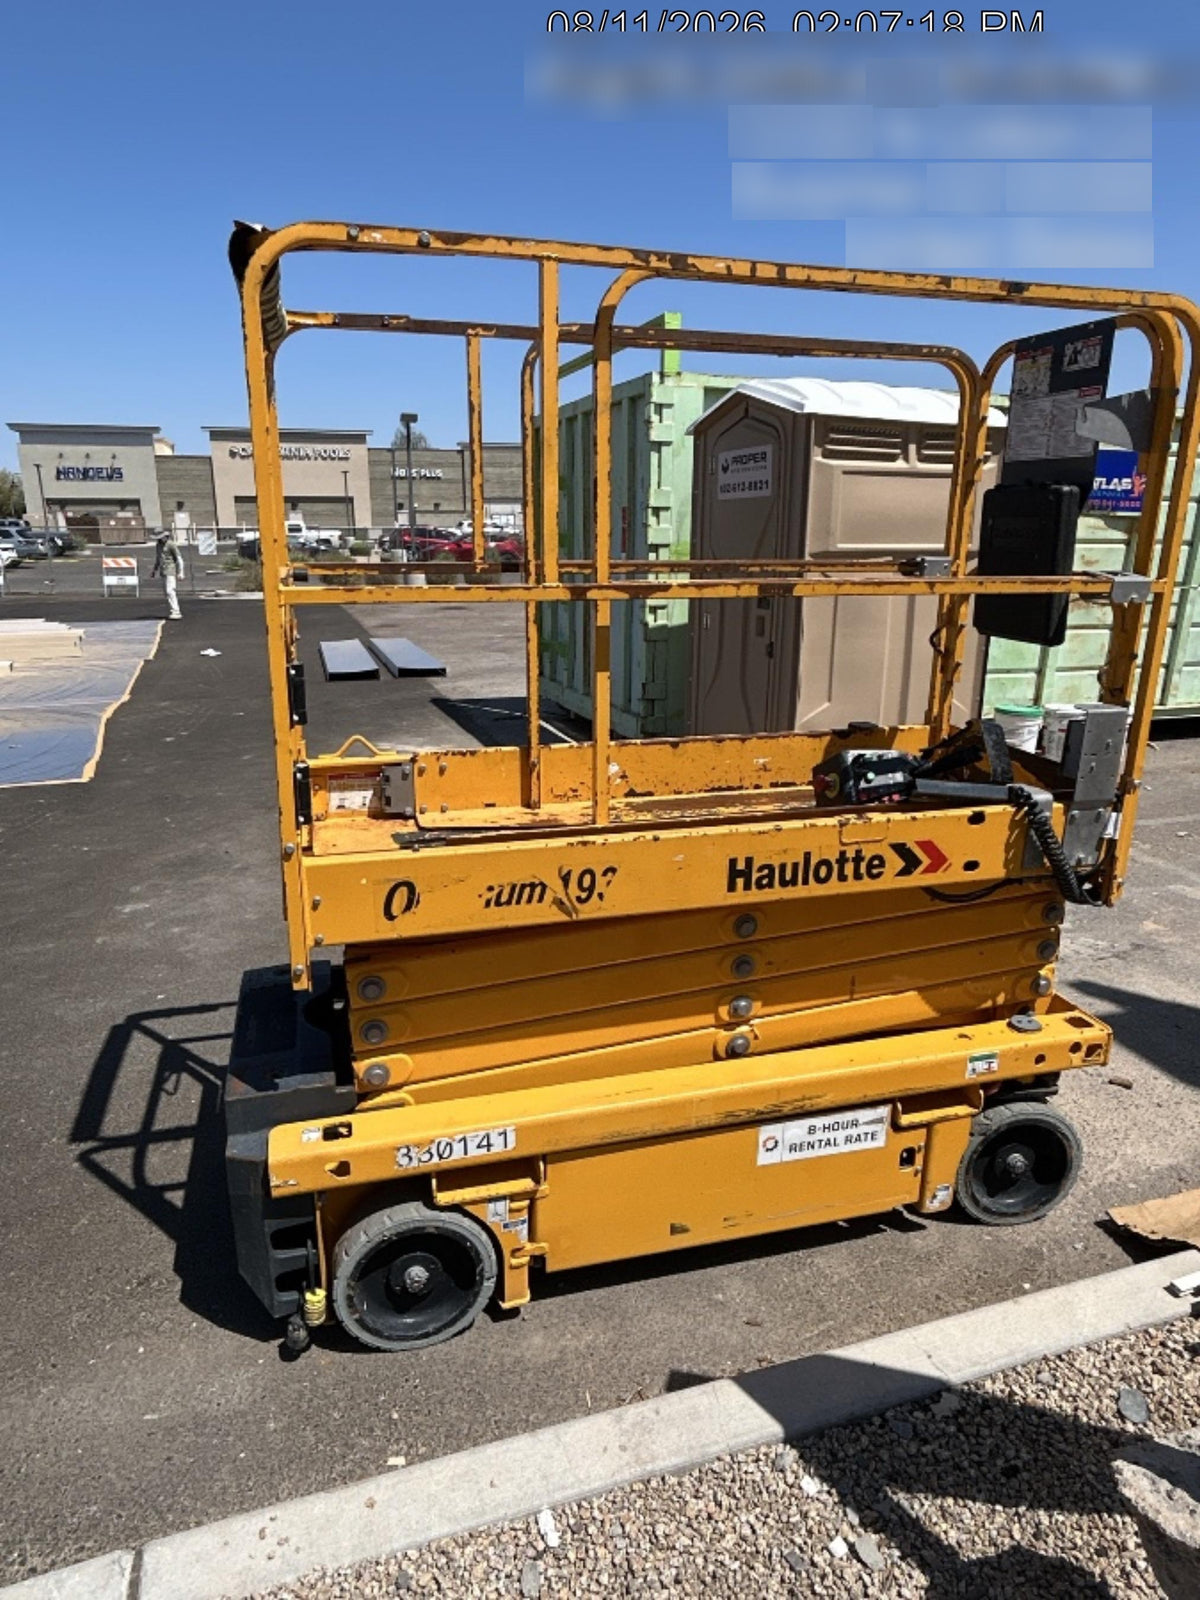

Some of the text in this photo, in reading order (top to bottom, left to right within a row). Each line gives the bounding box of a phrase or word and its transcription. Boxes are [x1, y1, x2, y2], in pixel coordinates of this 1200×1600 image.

[726, 848, 887, 893] Haulotte
[396, 1128, 508, 1168] 330141
[788, 1130, 878, 1154] RENTAL RATE
